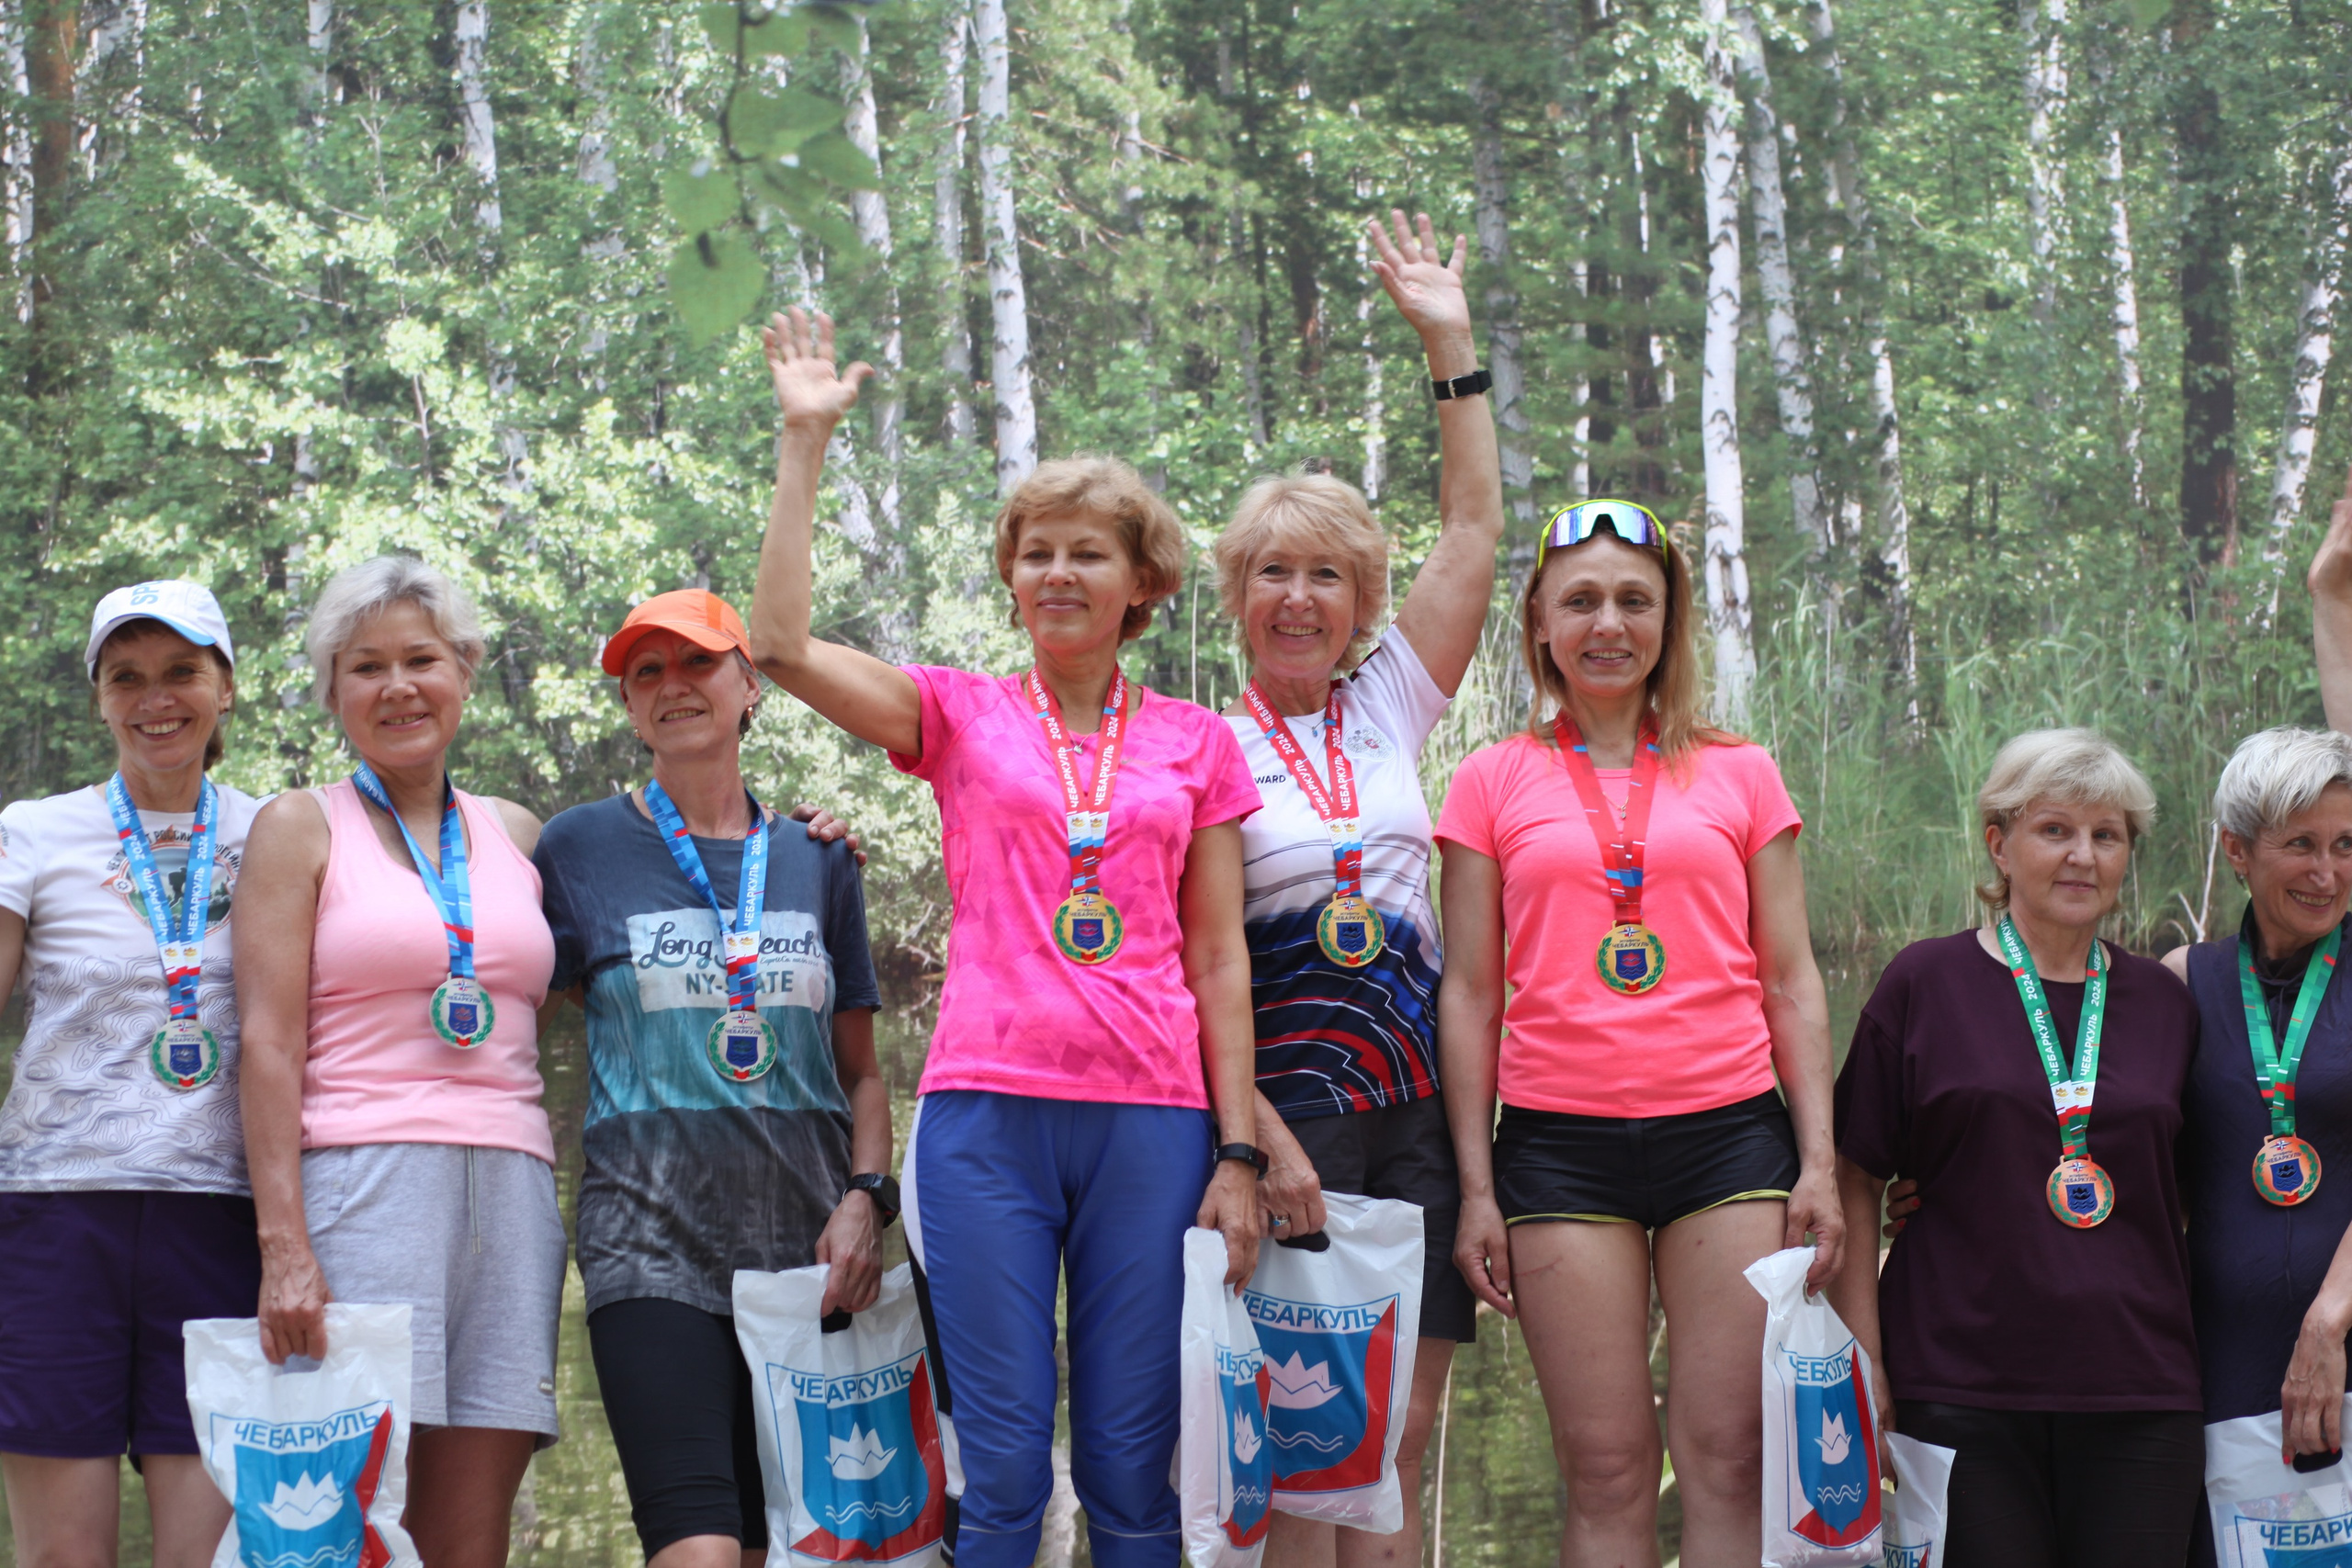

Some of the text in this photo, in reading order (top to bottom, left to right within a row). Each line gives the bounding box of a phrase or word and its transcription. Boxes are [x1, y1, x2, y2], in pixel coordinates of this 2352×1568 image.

[130, 580, 164, 606] SP
[1046, 716, 1062, 739] 2024
[1275, 732, 1295, 755] 2024
[1332, 728, 1341, 750] 2024
[1057, 746, 1079, 808] ЧЕБАРКУЛЬ
[1094, 744, 1114, 806] ЧЕБАРКУЛЬ
[1107, 716, 1119, 739] 2024
[1254, 774, 1286, 784] WARD
[1295, 759, 1331, 816] ЧЕБАРКУЛЬ
[1334, 754, 1351, 811] ЧЕБАРКУЛЬ
[130, 834, 145, 861] 2024
[143, 867, 169, 936] ЧЕБАРКУЛЬ
[187, 866, 206, 935] ЧЕБАРКУЛЬ
[197, 835, 209, 860] 2024
[744, 863, 760, 926] ЧЕБАРКУЛЬ
[752, 834, 763, 856] 2024
[638, 921, 713, 970] Long
[2021, 974, 2038, 1000] 2024
[2033, 1008, 2060, 1077] ЧЕБАРКУЛЬ
[2080, 1013, 2098, 1077] ЧЕБАРКУЛЬ
[2091, 980, 2101, 1007] 2024
[234, 1411, 380, 1450] ЧЕБАРКУЛЬ
